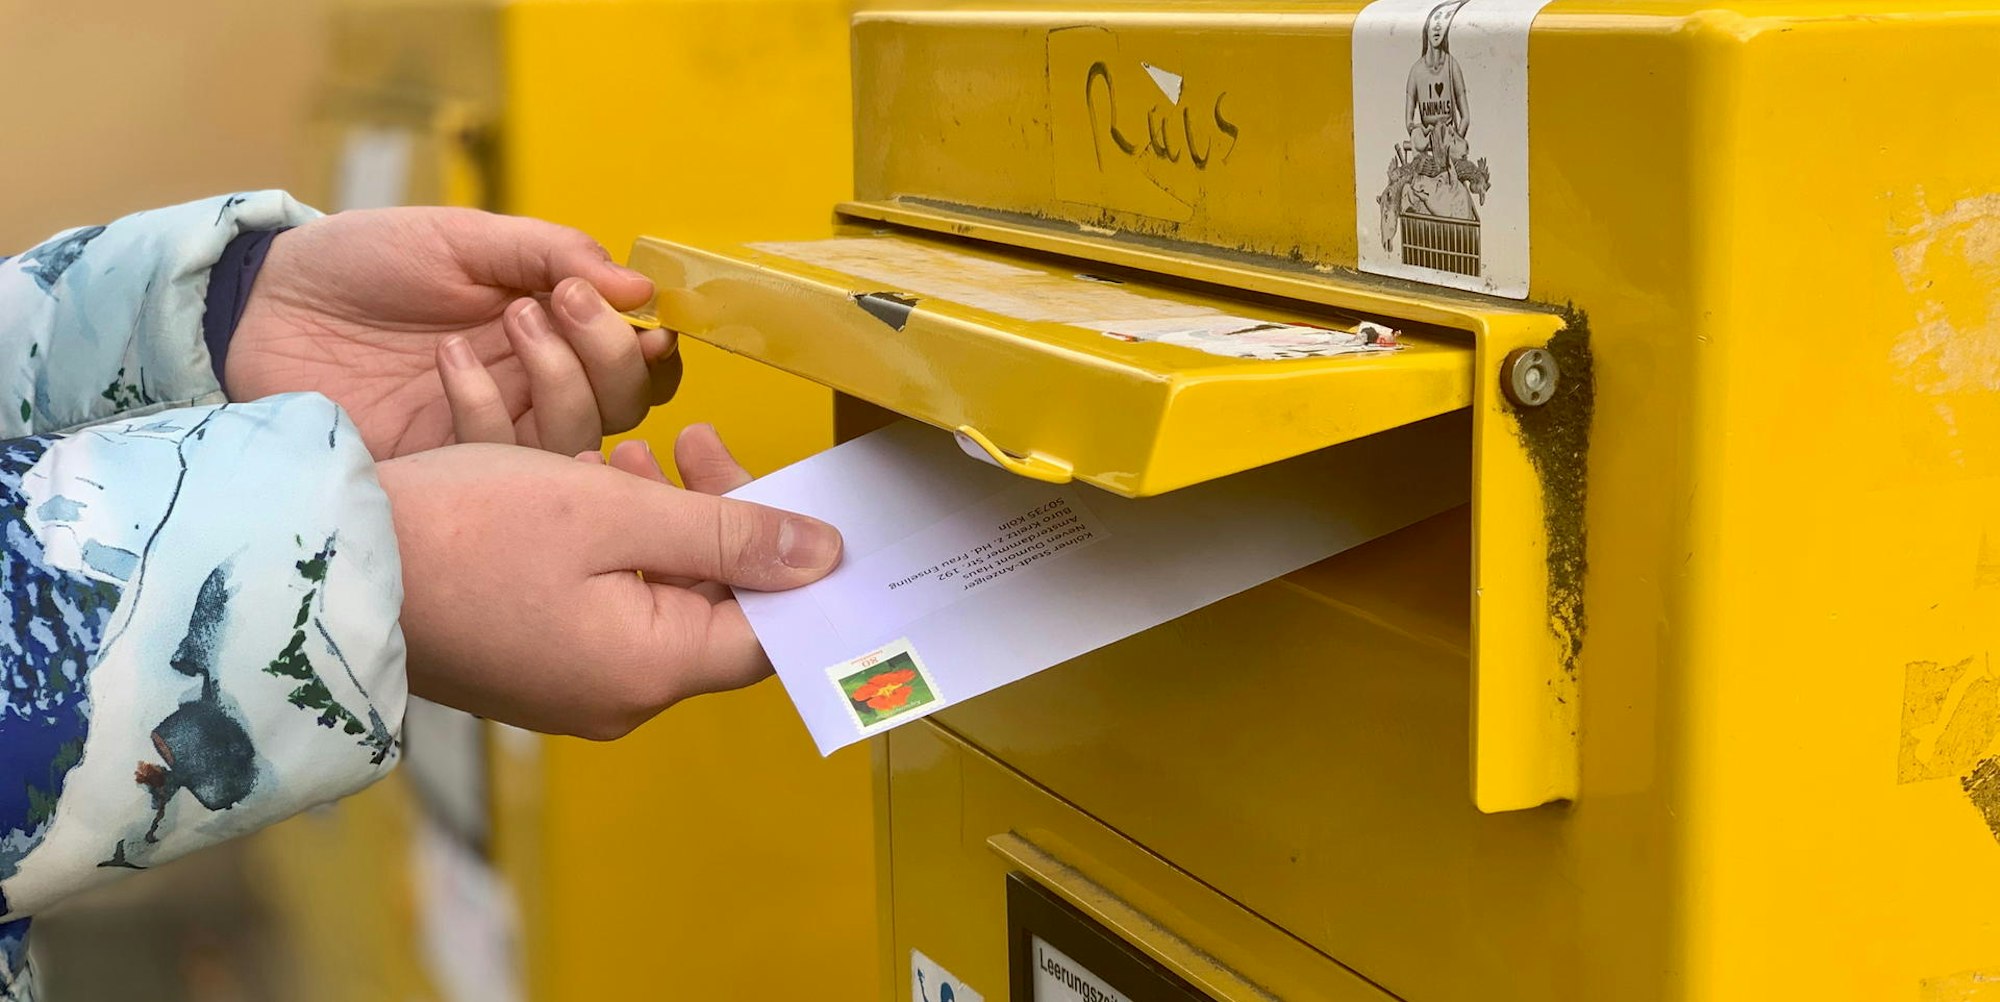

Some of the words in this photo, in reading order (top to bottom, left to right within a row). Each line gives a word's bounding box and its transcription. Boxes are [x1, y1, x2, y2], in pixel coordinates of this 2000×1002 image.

[1428, 83, 1432, 99] I
[1422, 100, 1450, 116] ANIMALS
[1027, 497, 1065, 519] 50735
[1042, 506, 1072, 523] Büro
[998, 515, 1026, 531] Köln
[1006, 521, 1041, 539] Kreitz
[986, 514, 1077, 560] Amsterdammer
[1046, 523, 1086, 543] Neven
[1054, 531, 1093, 552] Kölner
[970, 542, 992, 554] Hd.
[994, 541, 1045, 566] Dumont
[941, 552, 969, 568] Frau
[962, 556, 984, 568] Str.
[888, 565, 940, 590] Enseling
[936, 567, 960, 581] 192
[962, 563, 994, 579] Haus
[963, 549, 1052, 591] Stadt-Anzeiger
